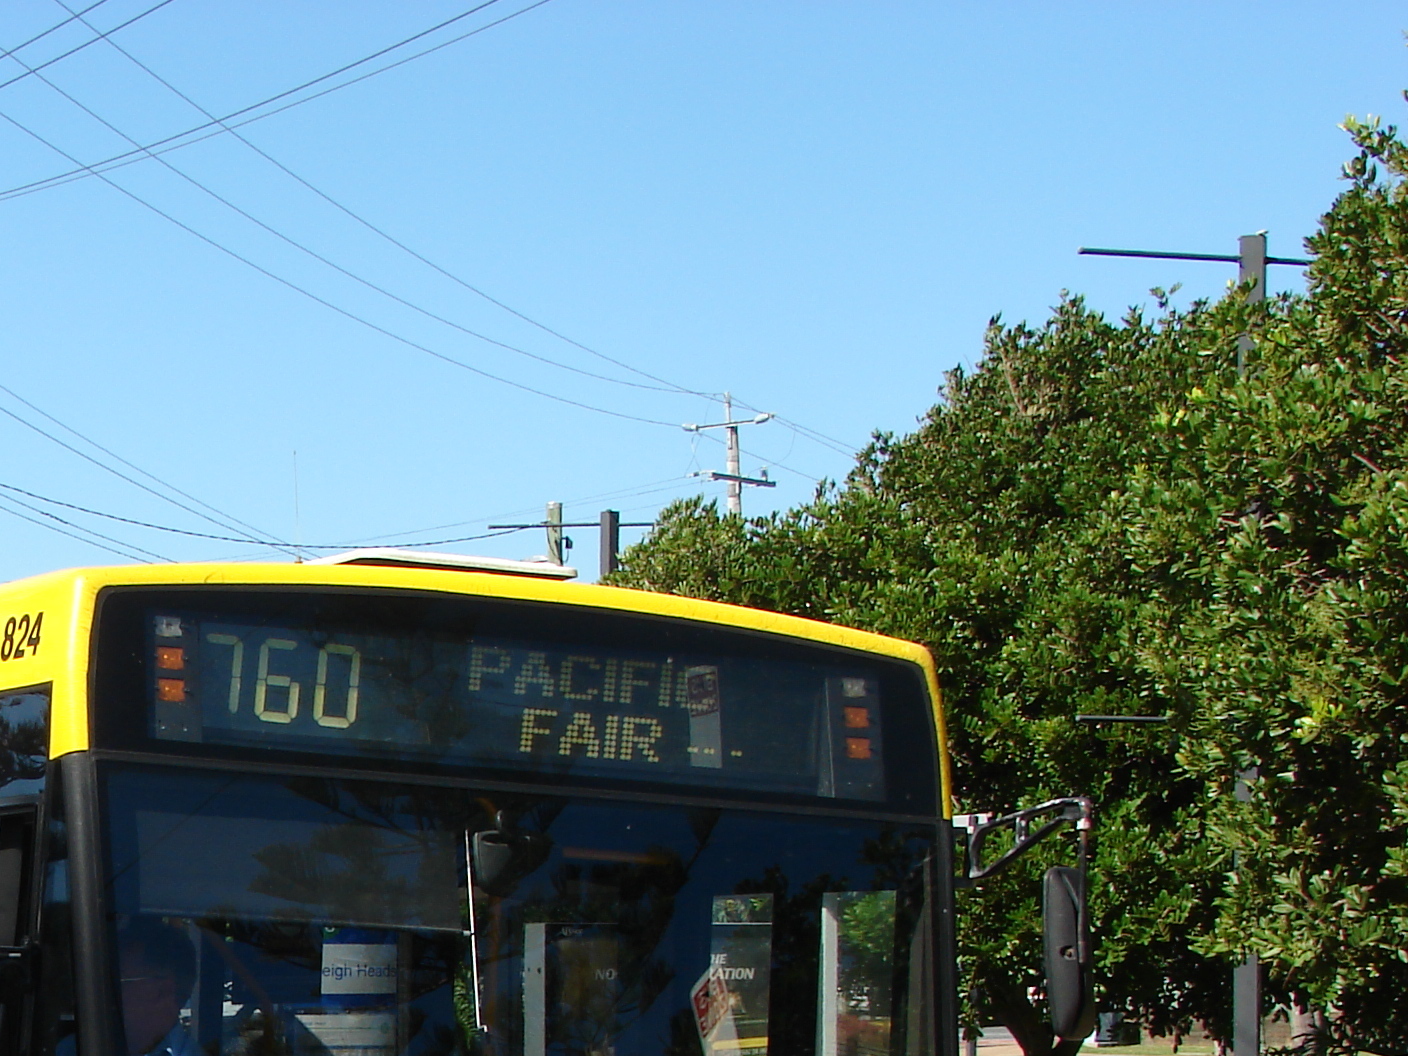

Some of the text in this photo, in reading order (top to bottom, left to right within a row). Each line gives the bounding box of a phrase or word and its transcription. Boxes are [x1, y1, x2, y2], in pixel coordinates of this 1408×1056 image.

[0, 611, 44, 662] 824
[206, 633, 360, 729] 760
[519, 708, 662, 763] FAIR
[709, 953, 728, 965] HE
[709, 967, 755, 980] ATION
